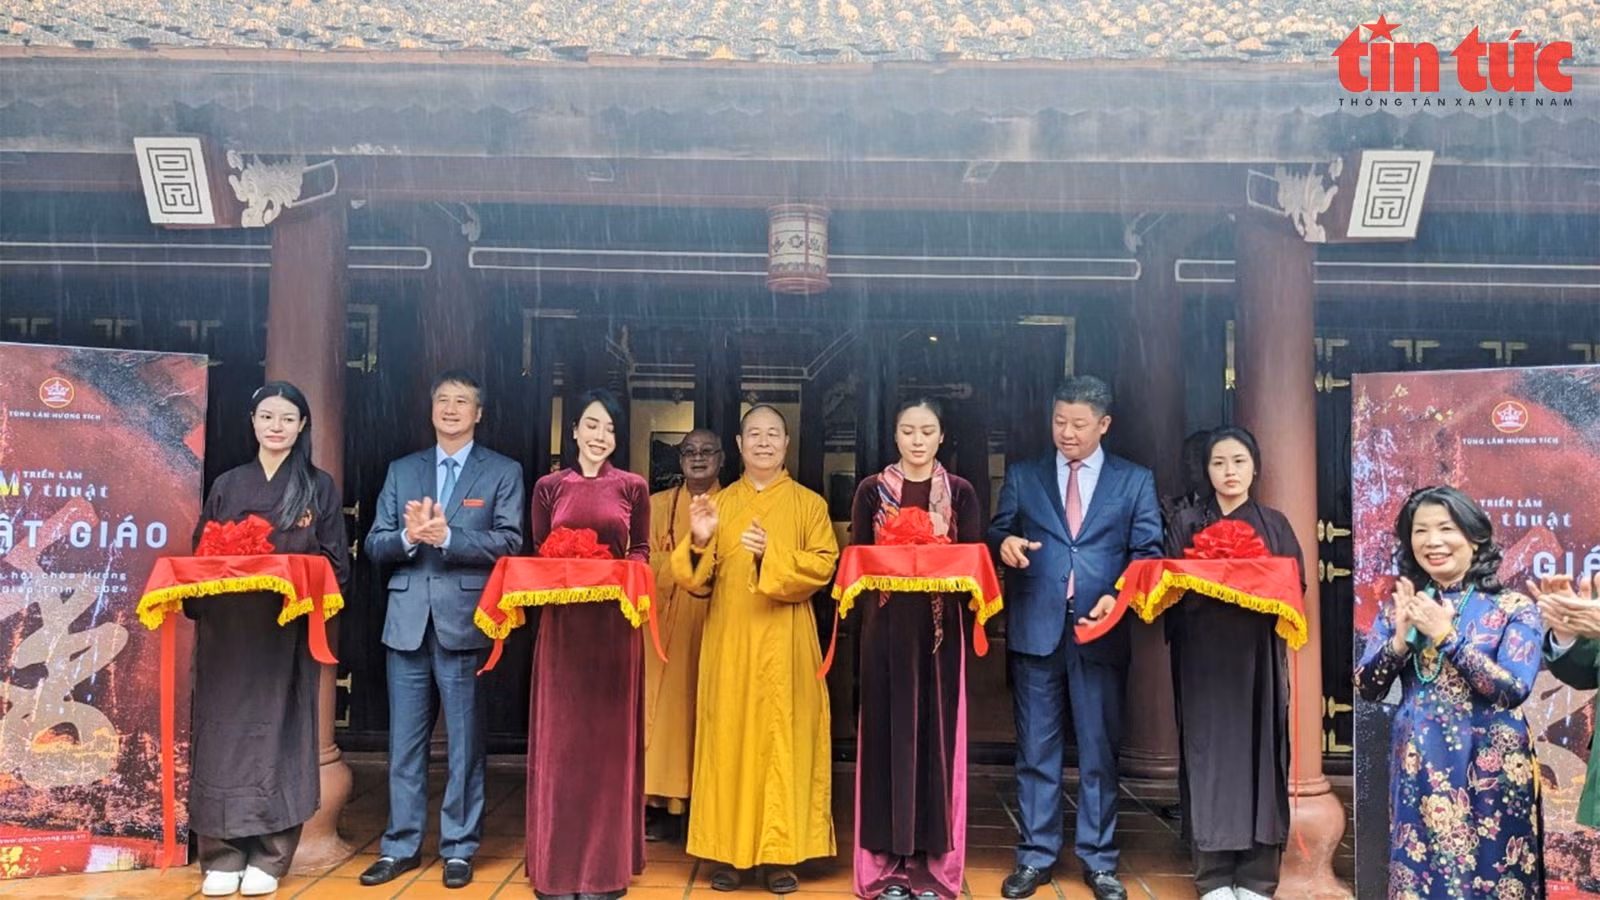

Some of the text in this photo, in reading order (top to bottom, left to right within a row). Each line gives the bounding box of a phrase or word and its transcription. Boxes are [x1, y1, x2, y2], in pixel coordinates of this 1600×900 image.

[43, 483, 108, 501] thuật
[1501, 511, 1572, 530] thuật
[70, 516, 168, 549] GIÁO
